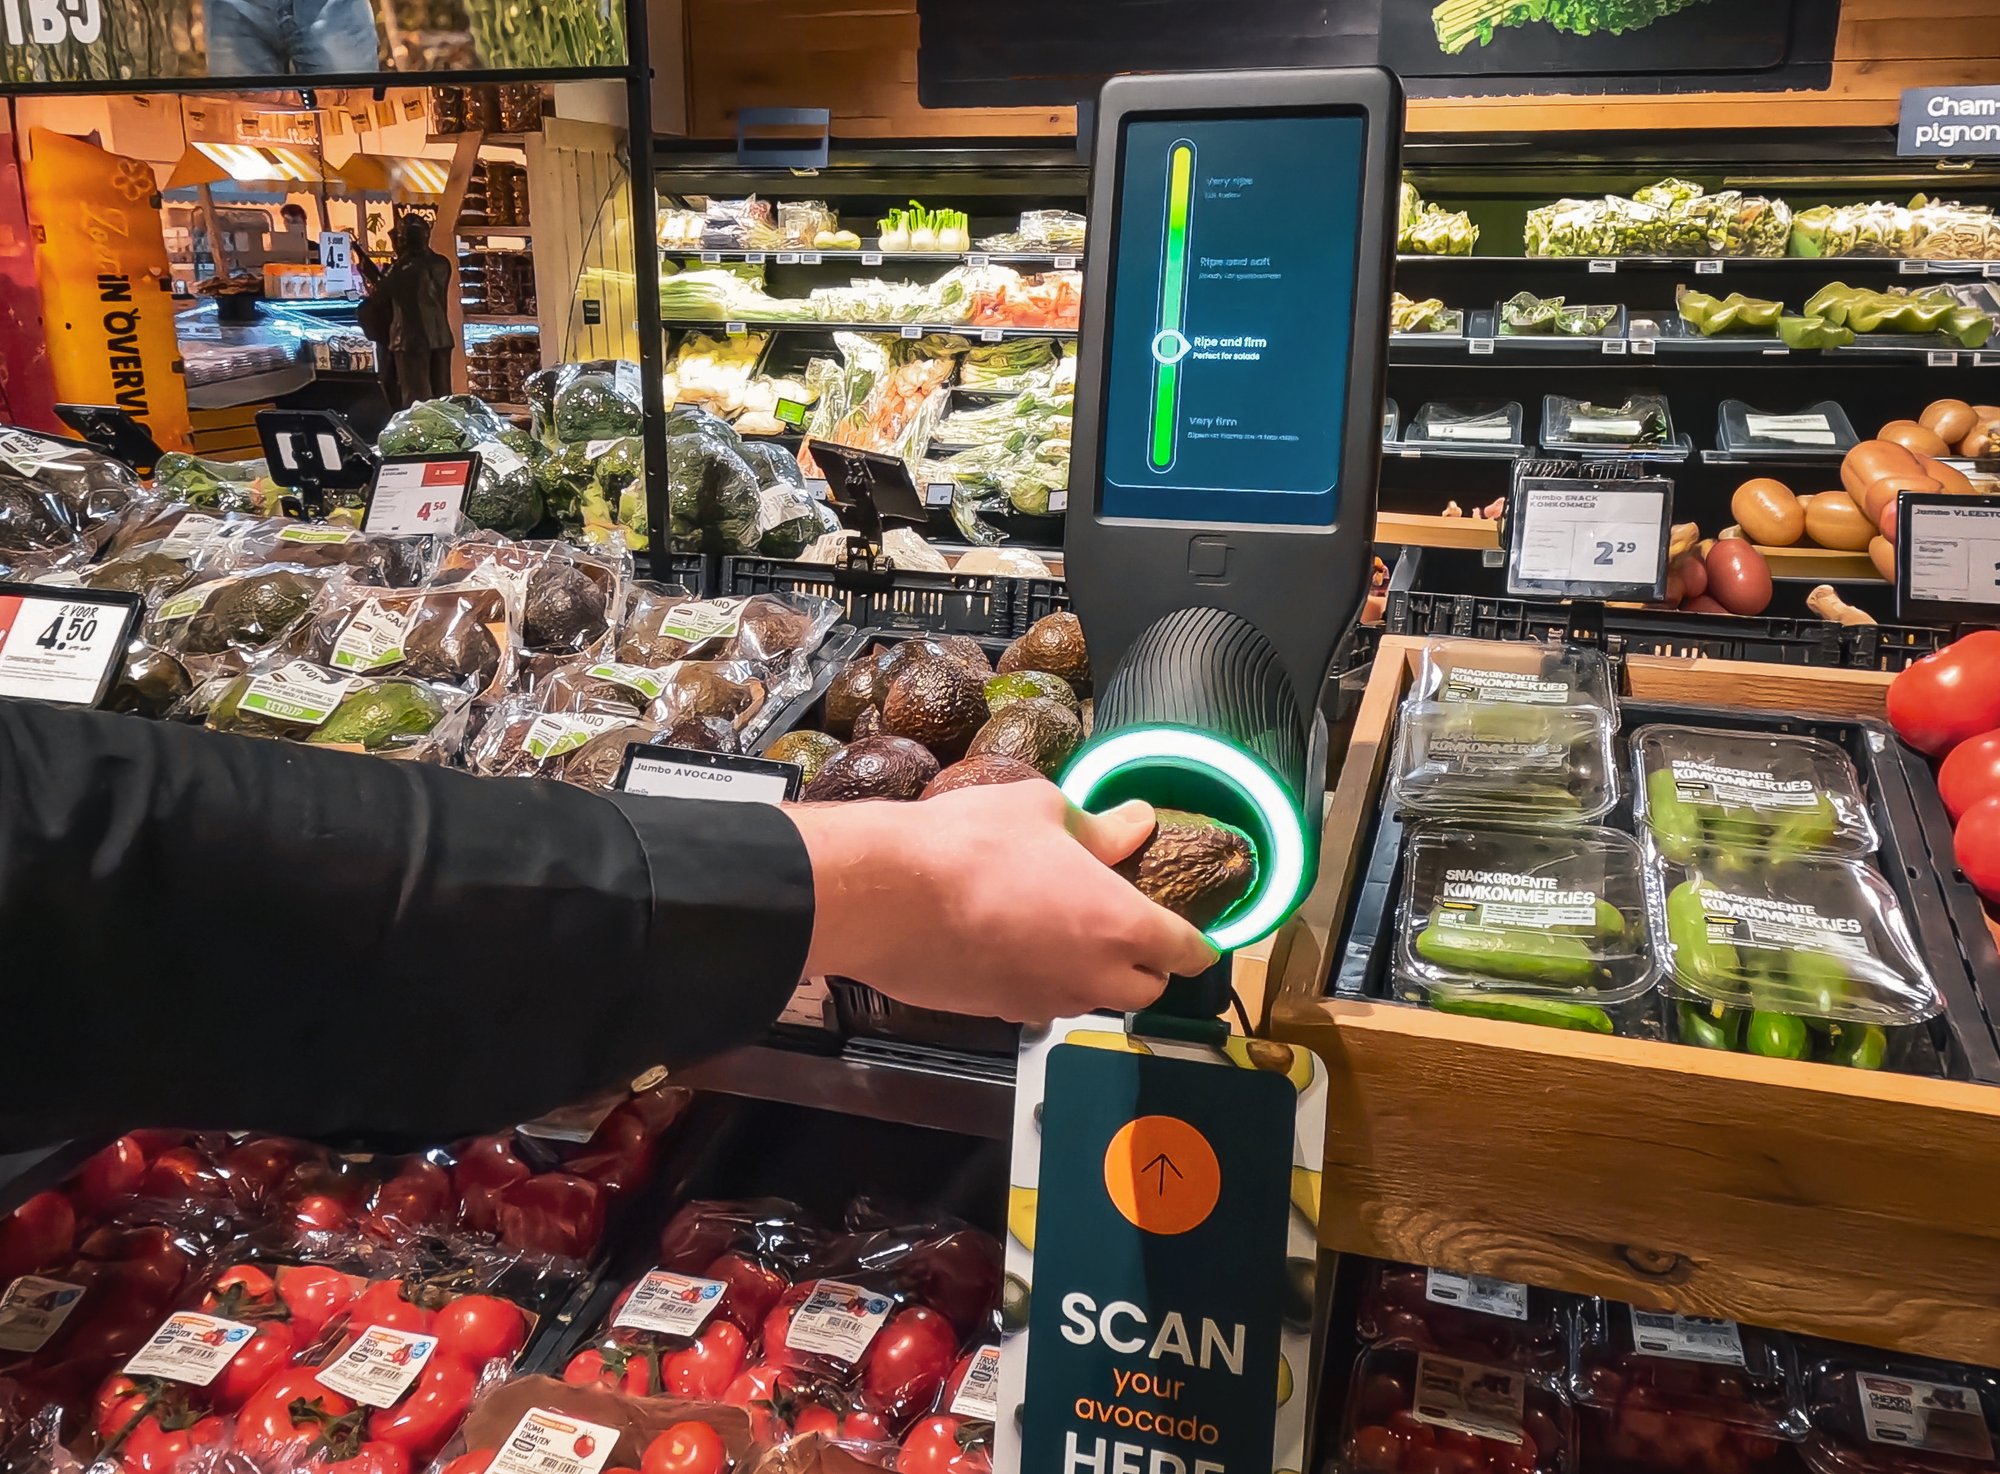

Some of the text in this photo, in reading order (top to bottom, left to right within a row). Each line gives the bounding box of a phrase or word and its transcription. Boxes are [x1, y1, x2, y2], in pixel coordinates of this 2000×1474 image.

[1194, 336, 1267, 349] Ripe and firm
[1192, 351, 1260, 361] Perfect for salads
[1189, 416, 1238, 428] Very firm
[59, 604, 99, 619] 2 VOOR
[1449, 672, 1569, 691] KOMKOMMERTJES
[634, 762, 733, 784] Jumbo AVOCADO
[1672, 768, 1813, 792] KOMKOMMERTJES
[1445, 869, 1559, 890] SNACKGROENTE
[1443, 881, 1596, 905] KOMKOMMERTJES
[1700, 897, 1863, 934] KOMKOMMERTJES
[1060, 1292, 1246, 1376] SCAN
[1113, 1367, 1186, 1400] your
[523, 1421, 545, 1434] ROMA
[1074, 1398, 1219, 1446] avocado
[519, 1430, 551, 1446] TOMATEN
